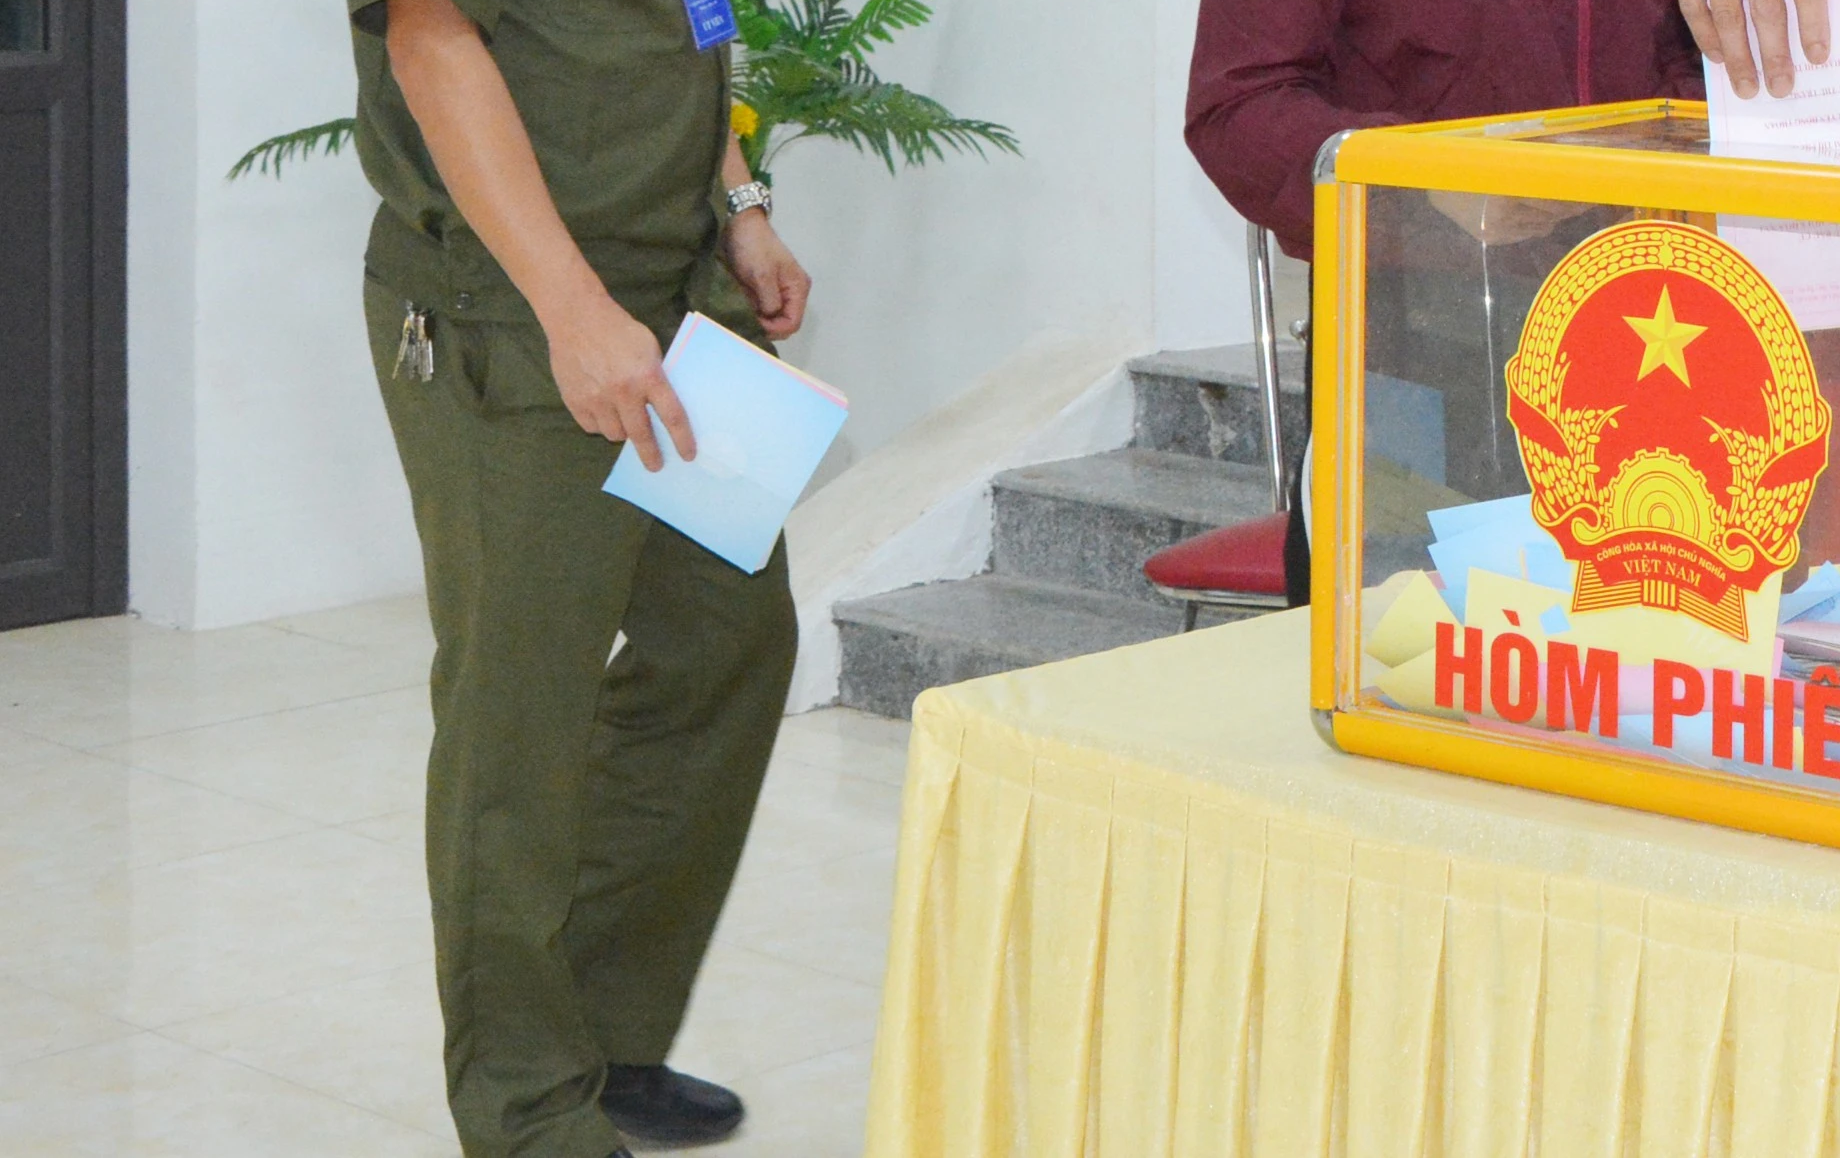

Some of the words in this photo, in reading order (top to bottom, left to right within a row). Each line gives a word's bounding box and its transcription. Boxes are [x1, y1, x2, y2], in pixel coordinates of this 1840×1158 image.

[1623, 555, 1661, 576] VIỆT
[1665, 562, 1701, 587] NAM
[1434, 609, 1620, 739] HÒM
